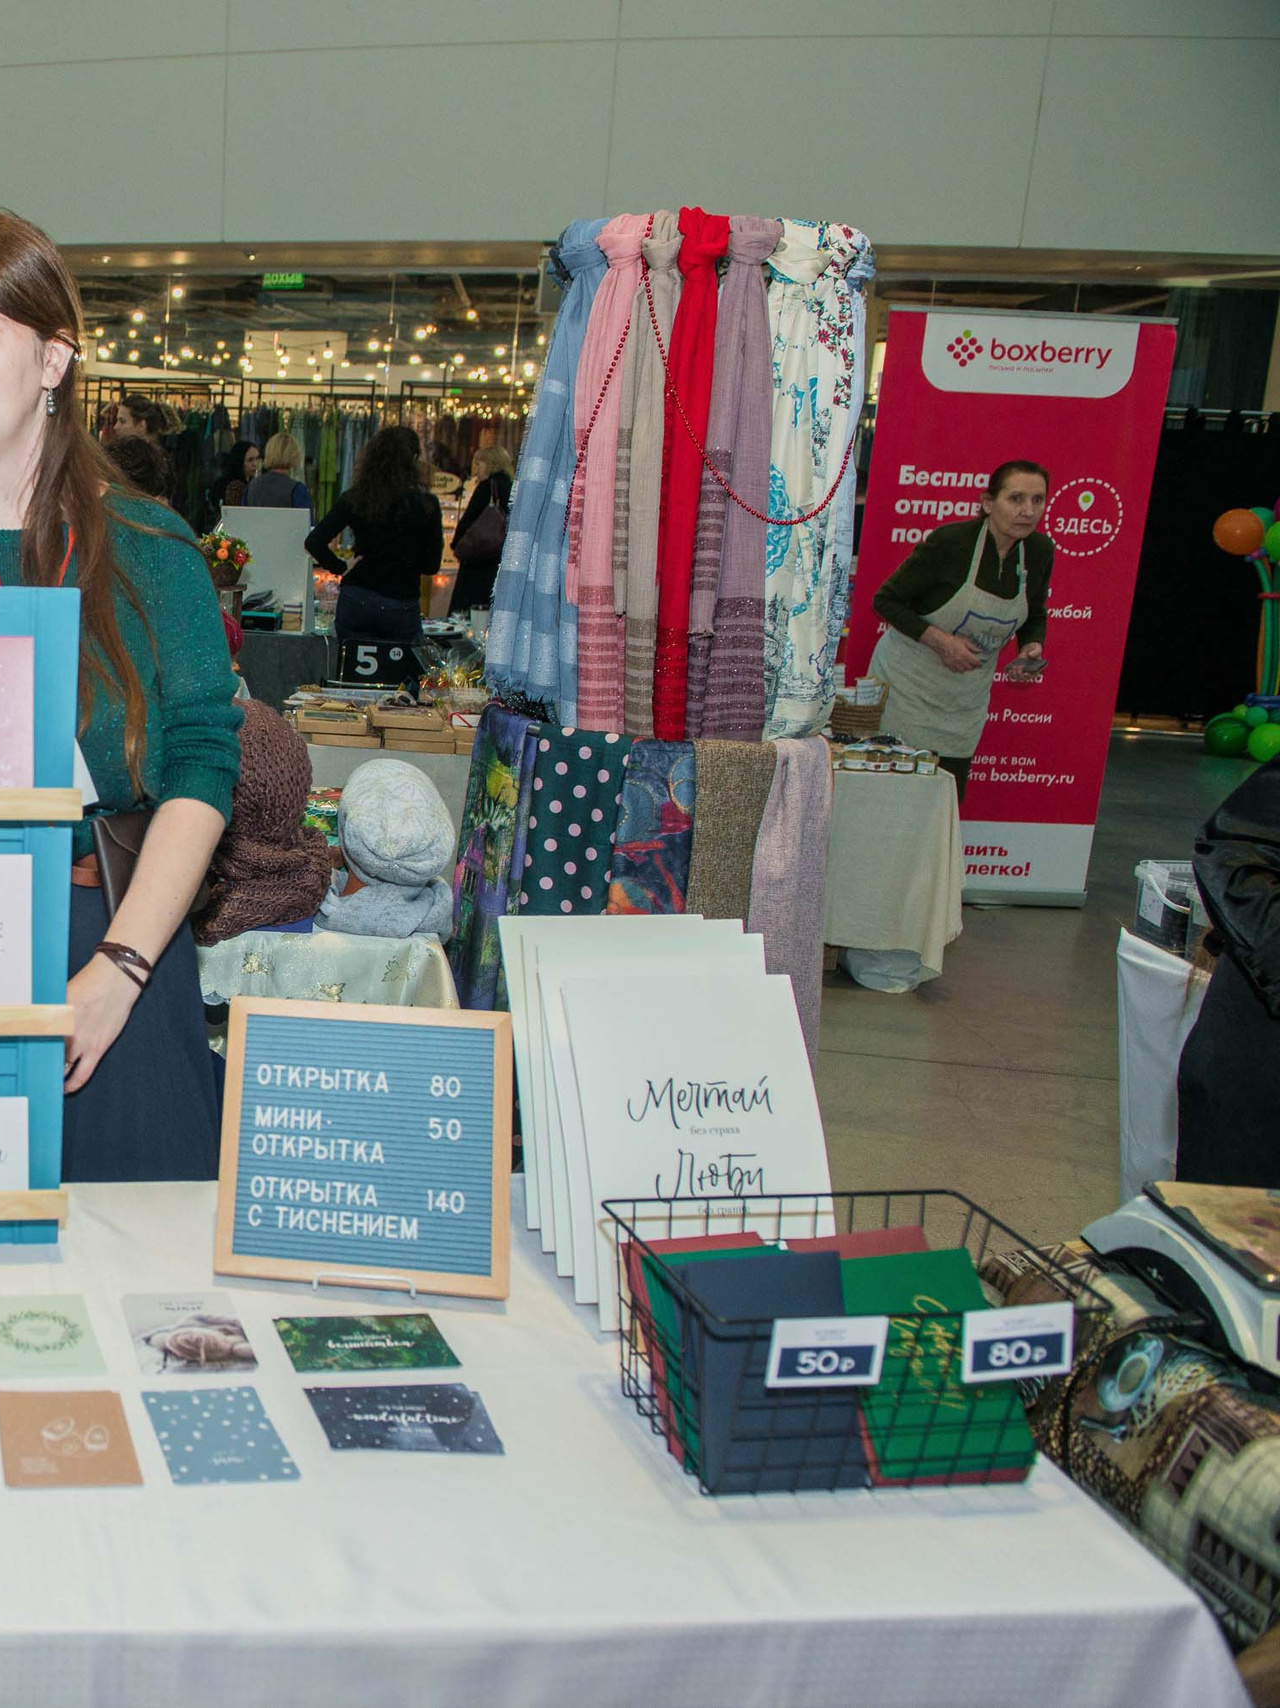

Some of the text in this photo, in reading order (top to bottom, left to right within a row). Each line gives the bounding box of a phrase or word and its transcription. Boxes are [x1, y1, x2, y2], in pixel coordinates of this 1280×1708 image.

[990, 337, 1113, 370] boxberry
[1054, 516, 1113, 536] ЗДЕСЬ
[355, 645, 378, 676] 5
[1003, 707, 1053, 724] России
[1000, 756, 1008, 766] к
[1011, 756, 1037, 767] вам
[989, 767, 1076, 788] boxberry.ru
[963, 845, 1008, 858] вить
[964, 861, 1032, 877] легко!
[256, 1063, 462, 1098] ОТКРЫТКА 80
[627, 1075, 774, 1130] Мечтай
[428, 1116, 462, 1141] 50
[252, 1133, 386, 1165] ОТКРЫТКА
[655, 1148, 764, 1203] Люби
[250, 1175, 466, 1215] ОТКРЫТКА 140
[247, 1203, 420, 1241] С ТИСНЕНИЕМ
